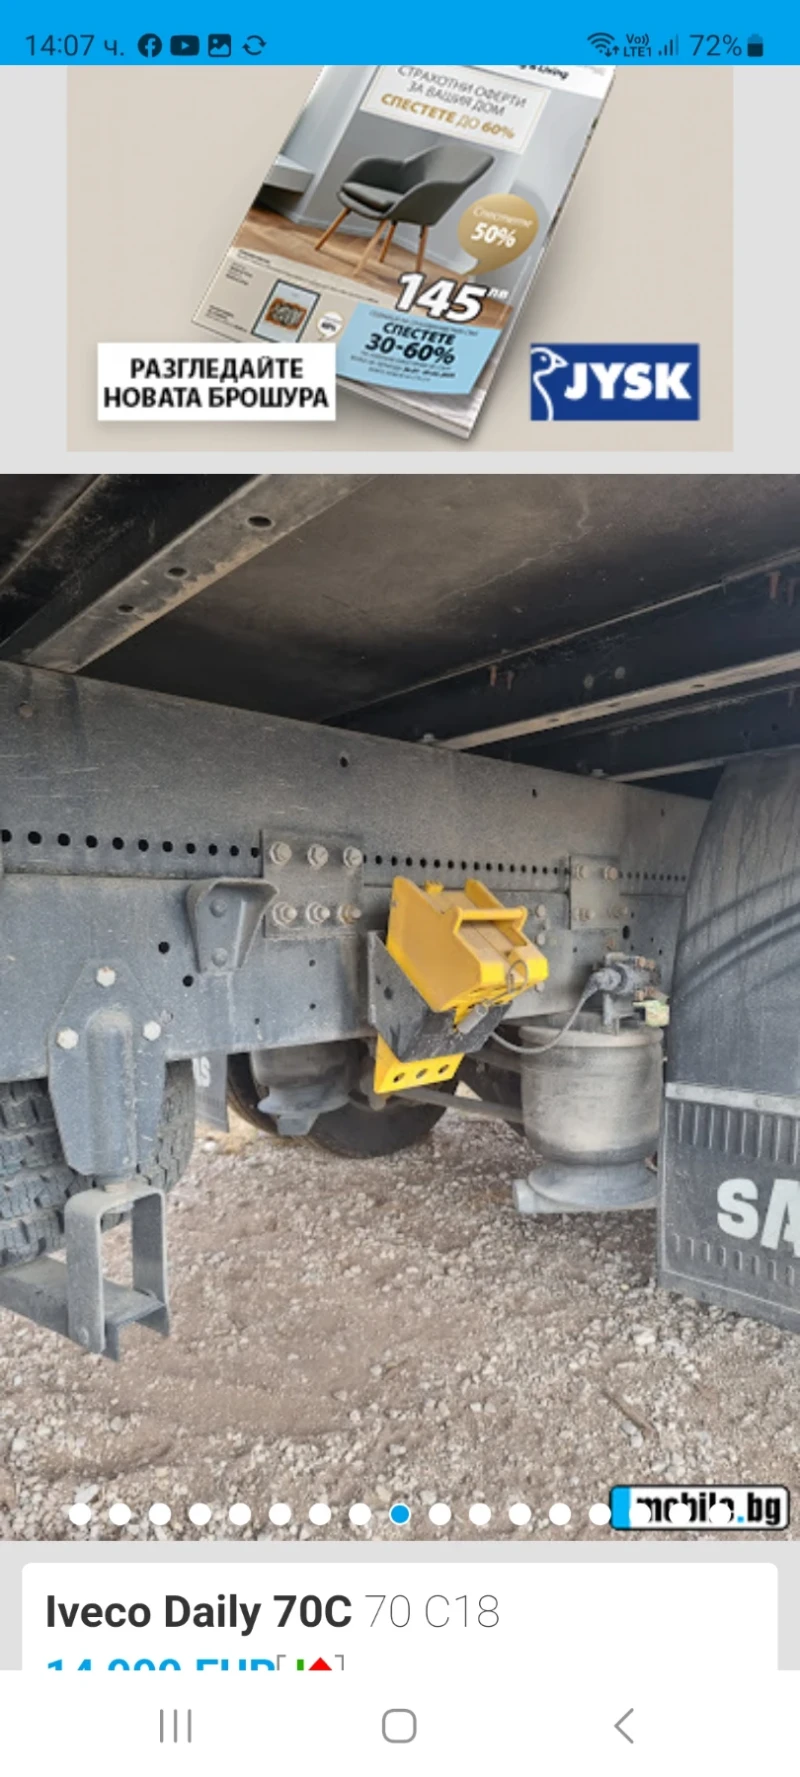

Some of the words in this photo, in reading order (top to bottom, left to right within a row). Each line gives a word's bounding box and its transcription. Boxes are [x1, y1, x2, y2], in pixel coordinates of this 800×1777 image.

[25, 34, 95, 57] 14:07
[103, 40, 124, 57] ч.
[623, 46, 652, 57] LTE1
[689, 34, 743, 57] 72%
[381, 93, 457, 123] СПЕСТЕТЕ
[456, 114, 481, 130] ДО
[481, 120, 516, 140] 60%
[470, 221, 517, 248] 50%
[396, 271, 489, 324] 145
[382, 321, 456, 346] СПЕСТЕТЕ
[365, 332, 456, 366] 30-60%
[130, 356, 303, 383] РАЗГЛЕДАЙТЕ
[564, 362, 692, 401] JYSK
[104, 387, 203, 408] НОВАТА
[208, 387, 329, 408] БРОШУРА
[46, 1594, 151, 1628] Iveco
[165, 1594, 262, 1637] Daily
[273, 1594, 352, 1628] 70C
[365, 1594, 411, 1628] 70
[425, 1594, 500, 1628] C18
